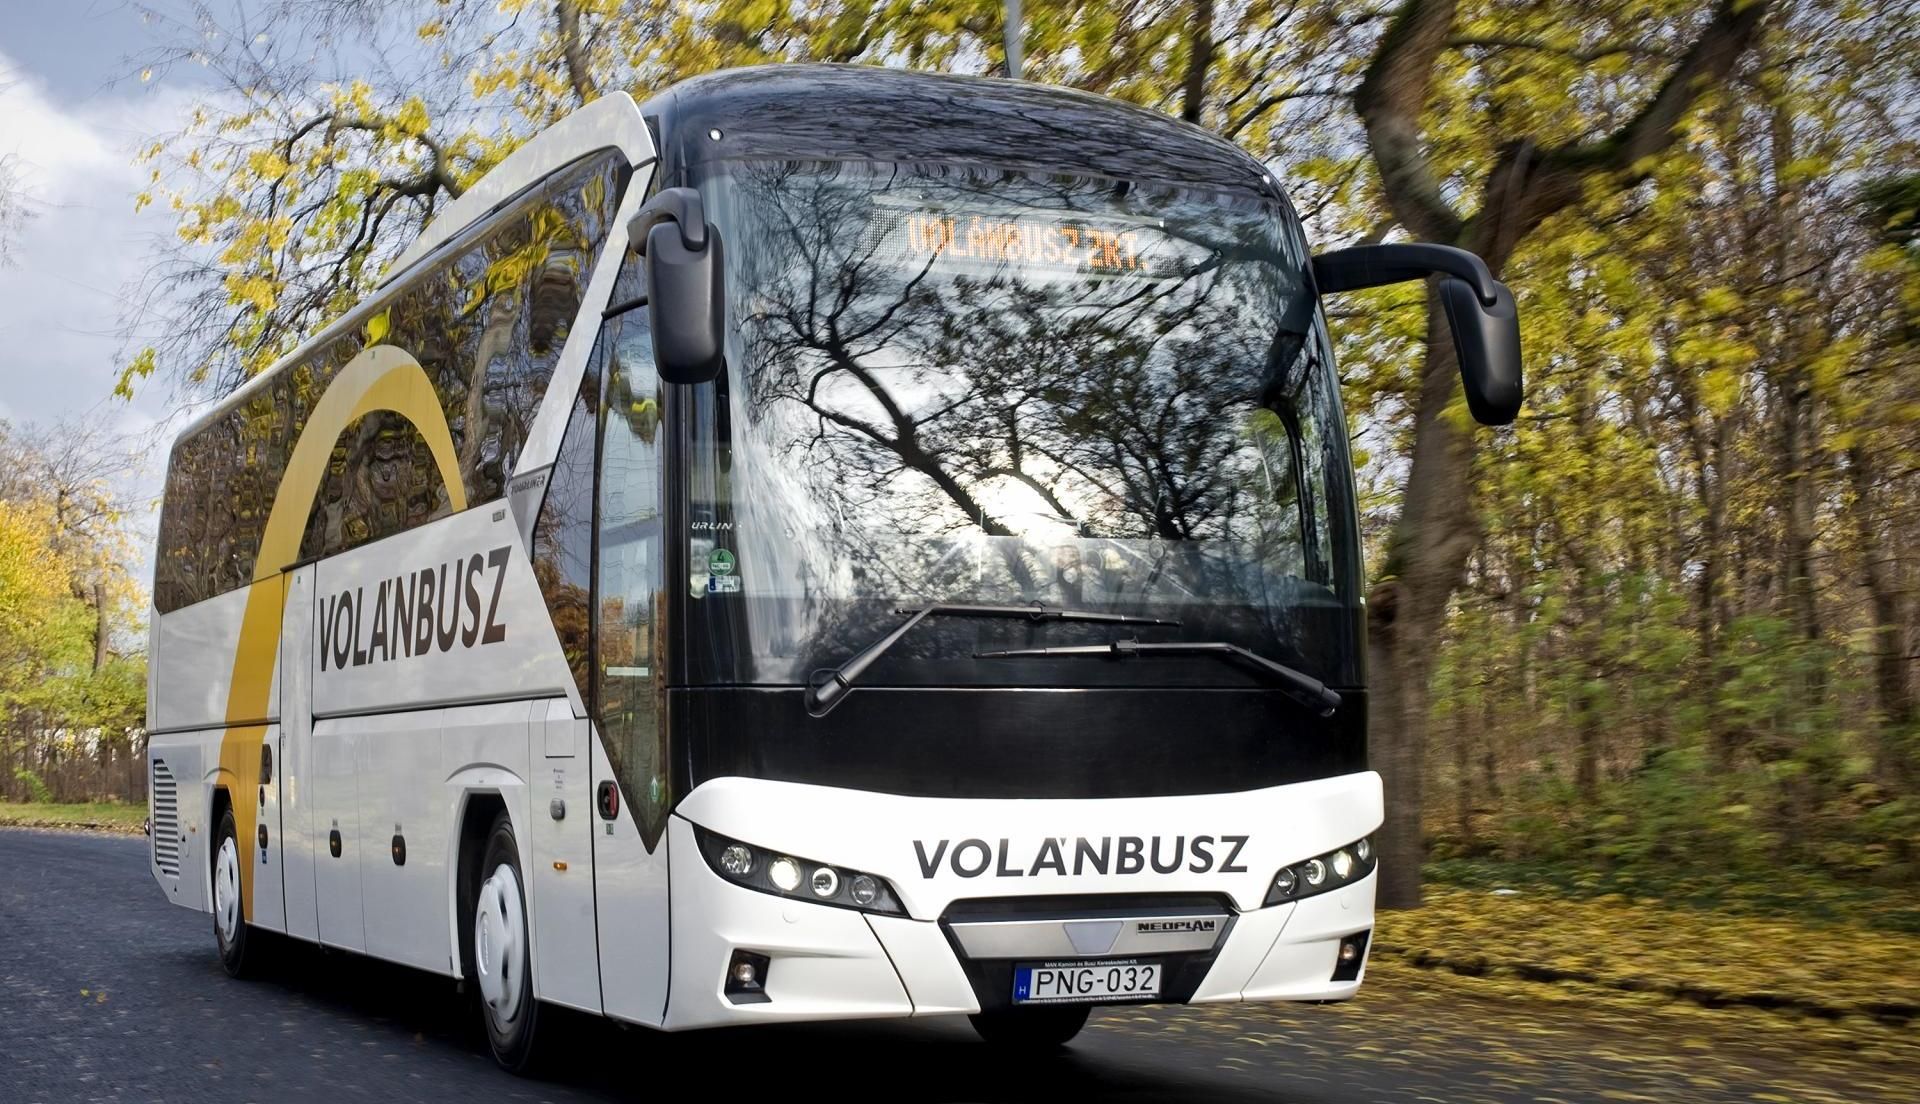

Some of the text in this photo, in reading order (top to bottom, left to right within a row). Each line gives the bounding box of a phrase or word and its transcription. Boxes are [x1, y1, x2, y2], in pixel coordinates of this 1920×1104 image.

[319, 545, 512, 672] VOLÁNBUSZ
[912, 835, 1250, 879] VOLÁNBUSZ
[1137, 919, 1215, 933] NEOPLAN
[1019, 985, 1027, 995] H
[1036, 966, 1154, 995] PNG-032
